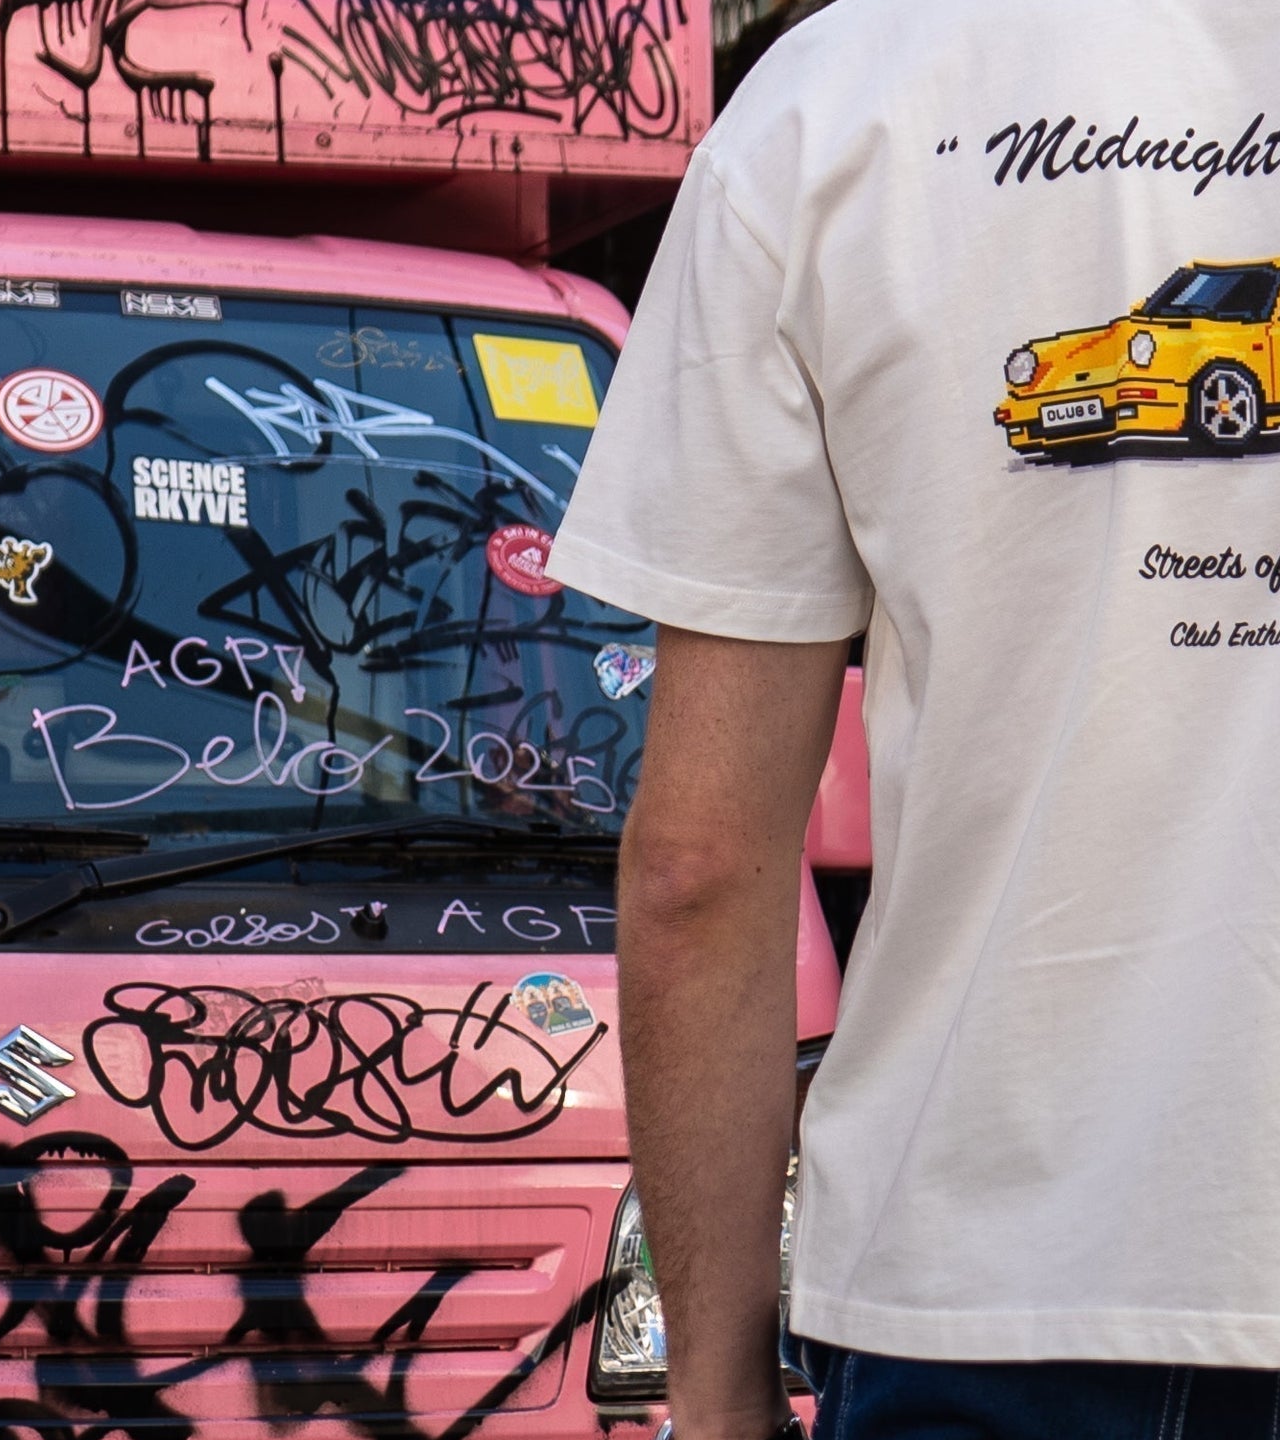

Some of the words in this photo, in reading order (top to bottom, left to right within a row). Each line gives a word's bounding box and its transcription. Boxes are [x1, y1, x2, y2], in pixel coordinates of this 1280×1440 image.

[133, 456, 247, 496] SCIENCE
[134, 486, 249, 528] RKYVE
[1138, 543, 1247, 580] Streets
[1170, 621, 1222, 648] Club
[405, 709, 616, 813] 2025
